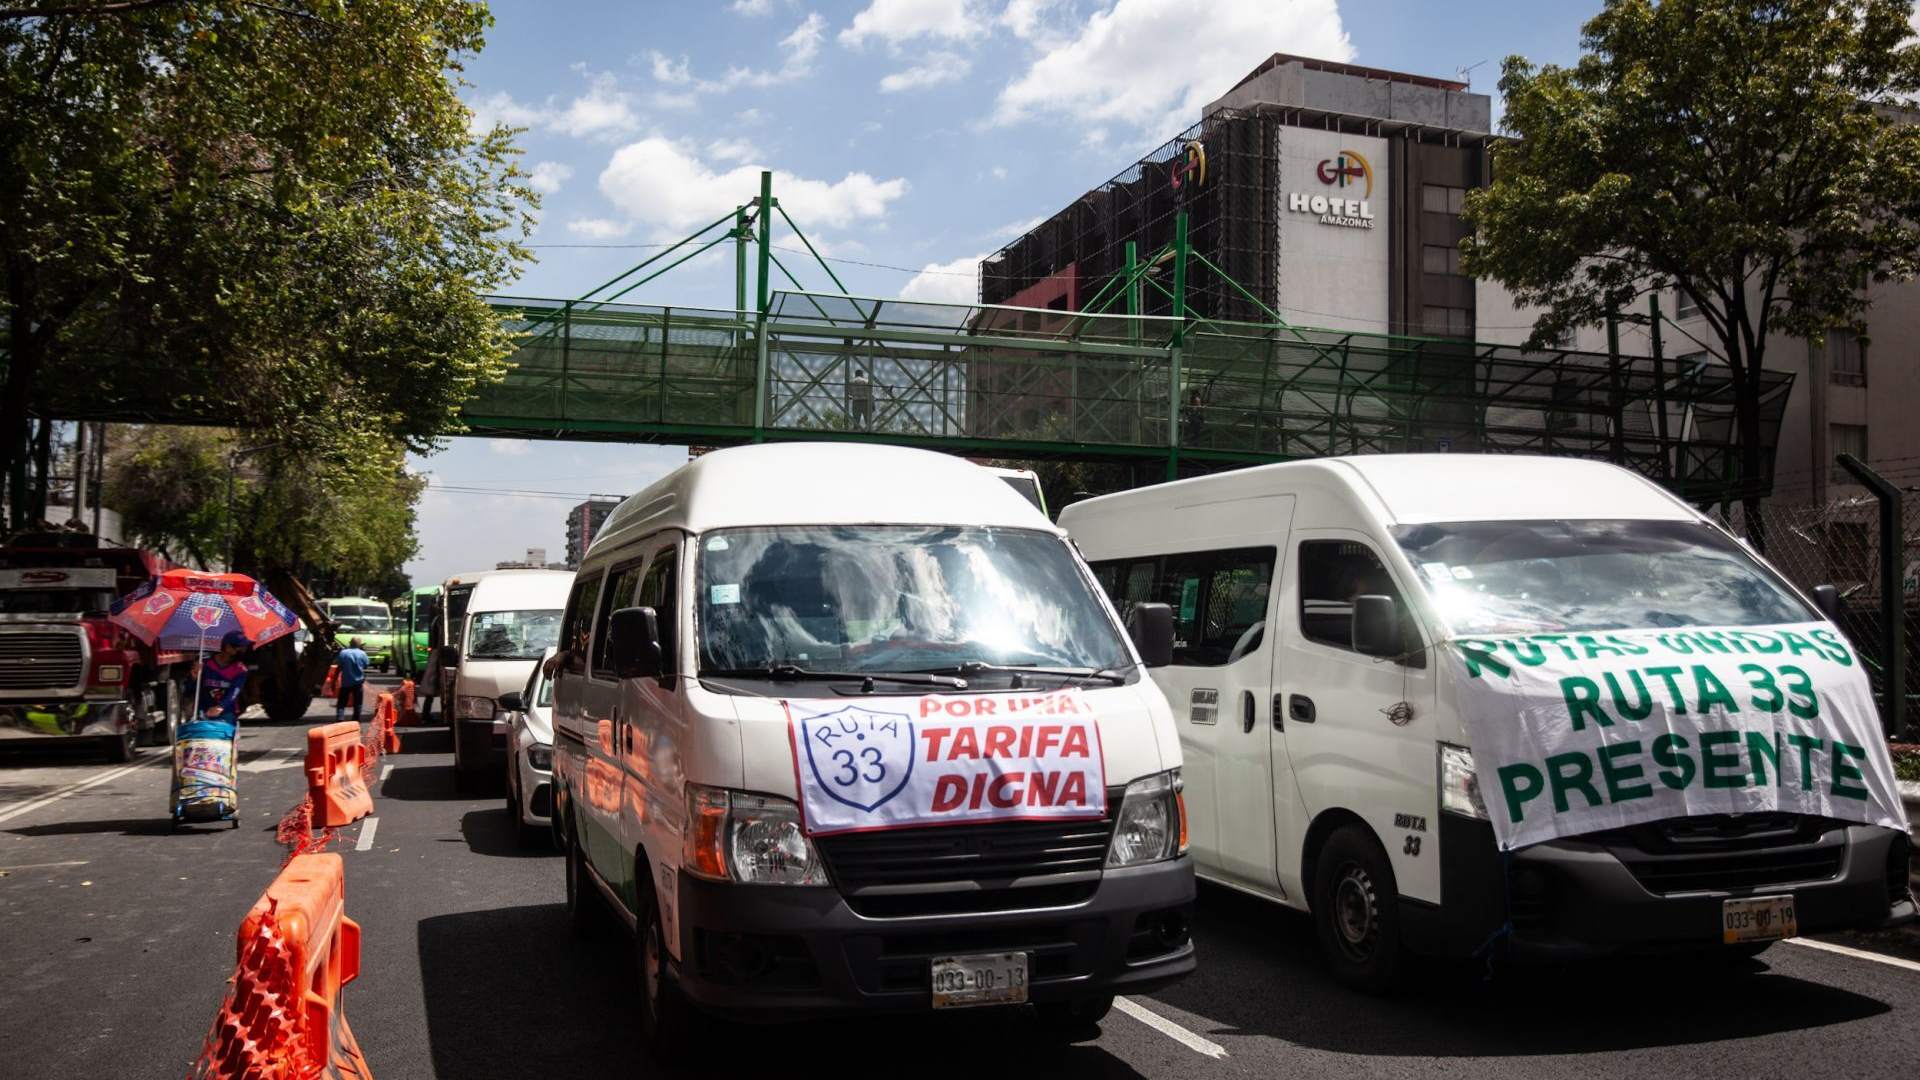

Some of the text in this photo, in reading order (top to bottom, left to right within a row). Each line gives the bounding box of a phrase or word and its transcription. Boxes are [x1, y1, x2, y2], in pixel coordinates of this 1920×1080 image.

[1289, 192, 1374, 219] HOTEL
[1320, 214, 1375, 229] AMAZONAS
[1455, 629, 1853, 679] RUTAS UNIDAS
[919, 697, 997, 718] POR
[1558, 663, 1819, 731] RUTA 33
[815, 715, 897, 748] RUTA
[921, 725, 1089, 762] TARIFA
[832, 747, 886, 787] 33
[1497, 730, 1868, 823] PRESENTE
[931, 771, 1087, 812] DIGNA
[1394, 813, 1427, 832] RUTA
[1403, 835, 1421, 857] 33
[1726, 907, 1793, 929] 033-00-19
[935, 967, 1024, 993] 033-00-13
